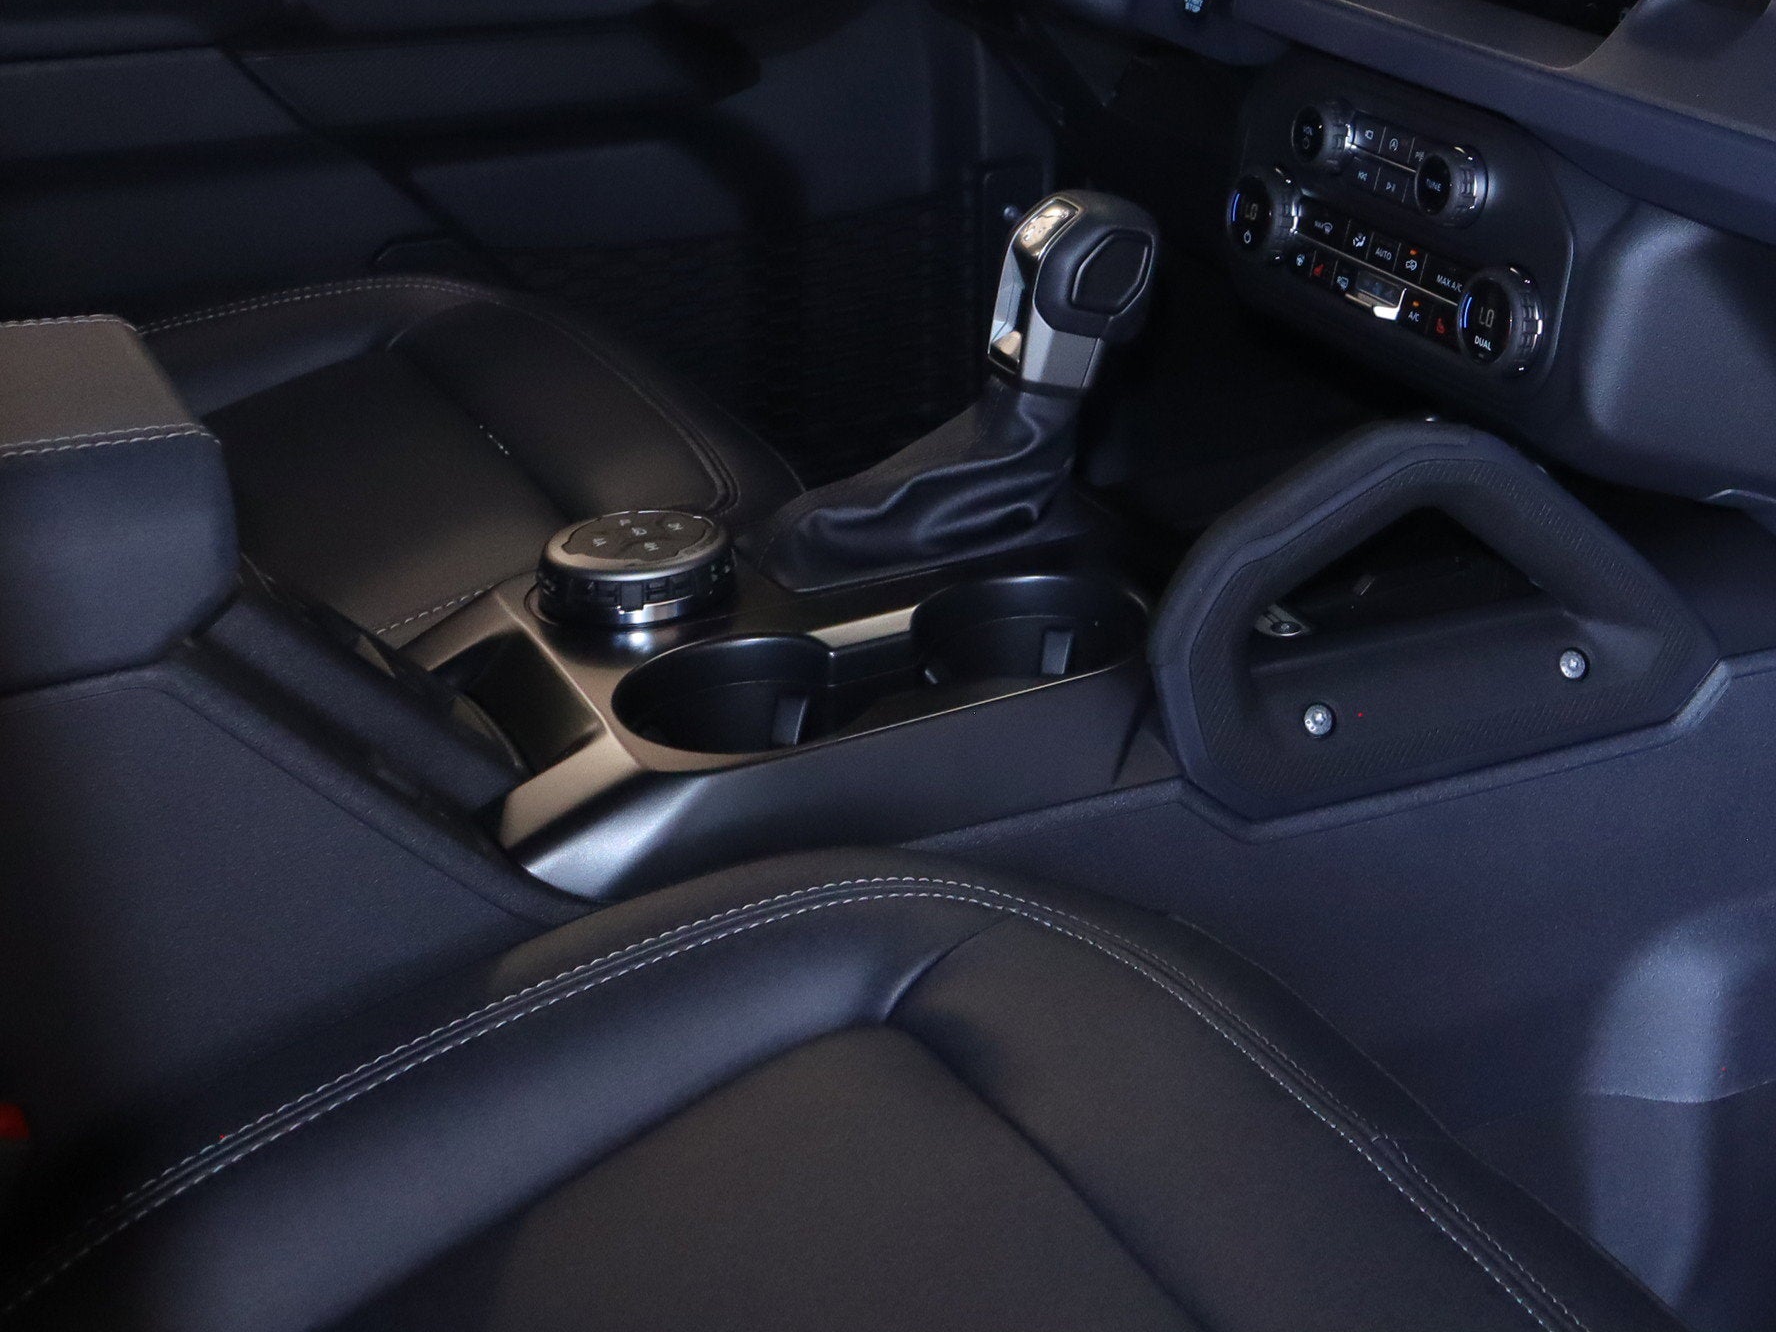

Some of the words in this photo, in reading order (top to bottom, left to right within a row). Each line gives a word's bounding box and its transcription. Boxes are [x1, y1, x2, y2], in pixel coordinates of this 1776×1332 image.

[1375, 247, 1392, 261] AUTO
[1437, 274, 1451, 288] MAX
[1451, 281, 1463, 294] A/C
[1408, 310, 1420, 323] A/C
[1474, 335, 1492, 351] DUAL
